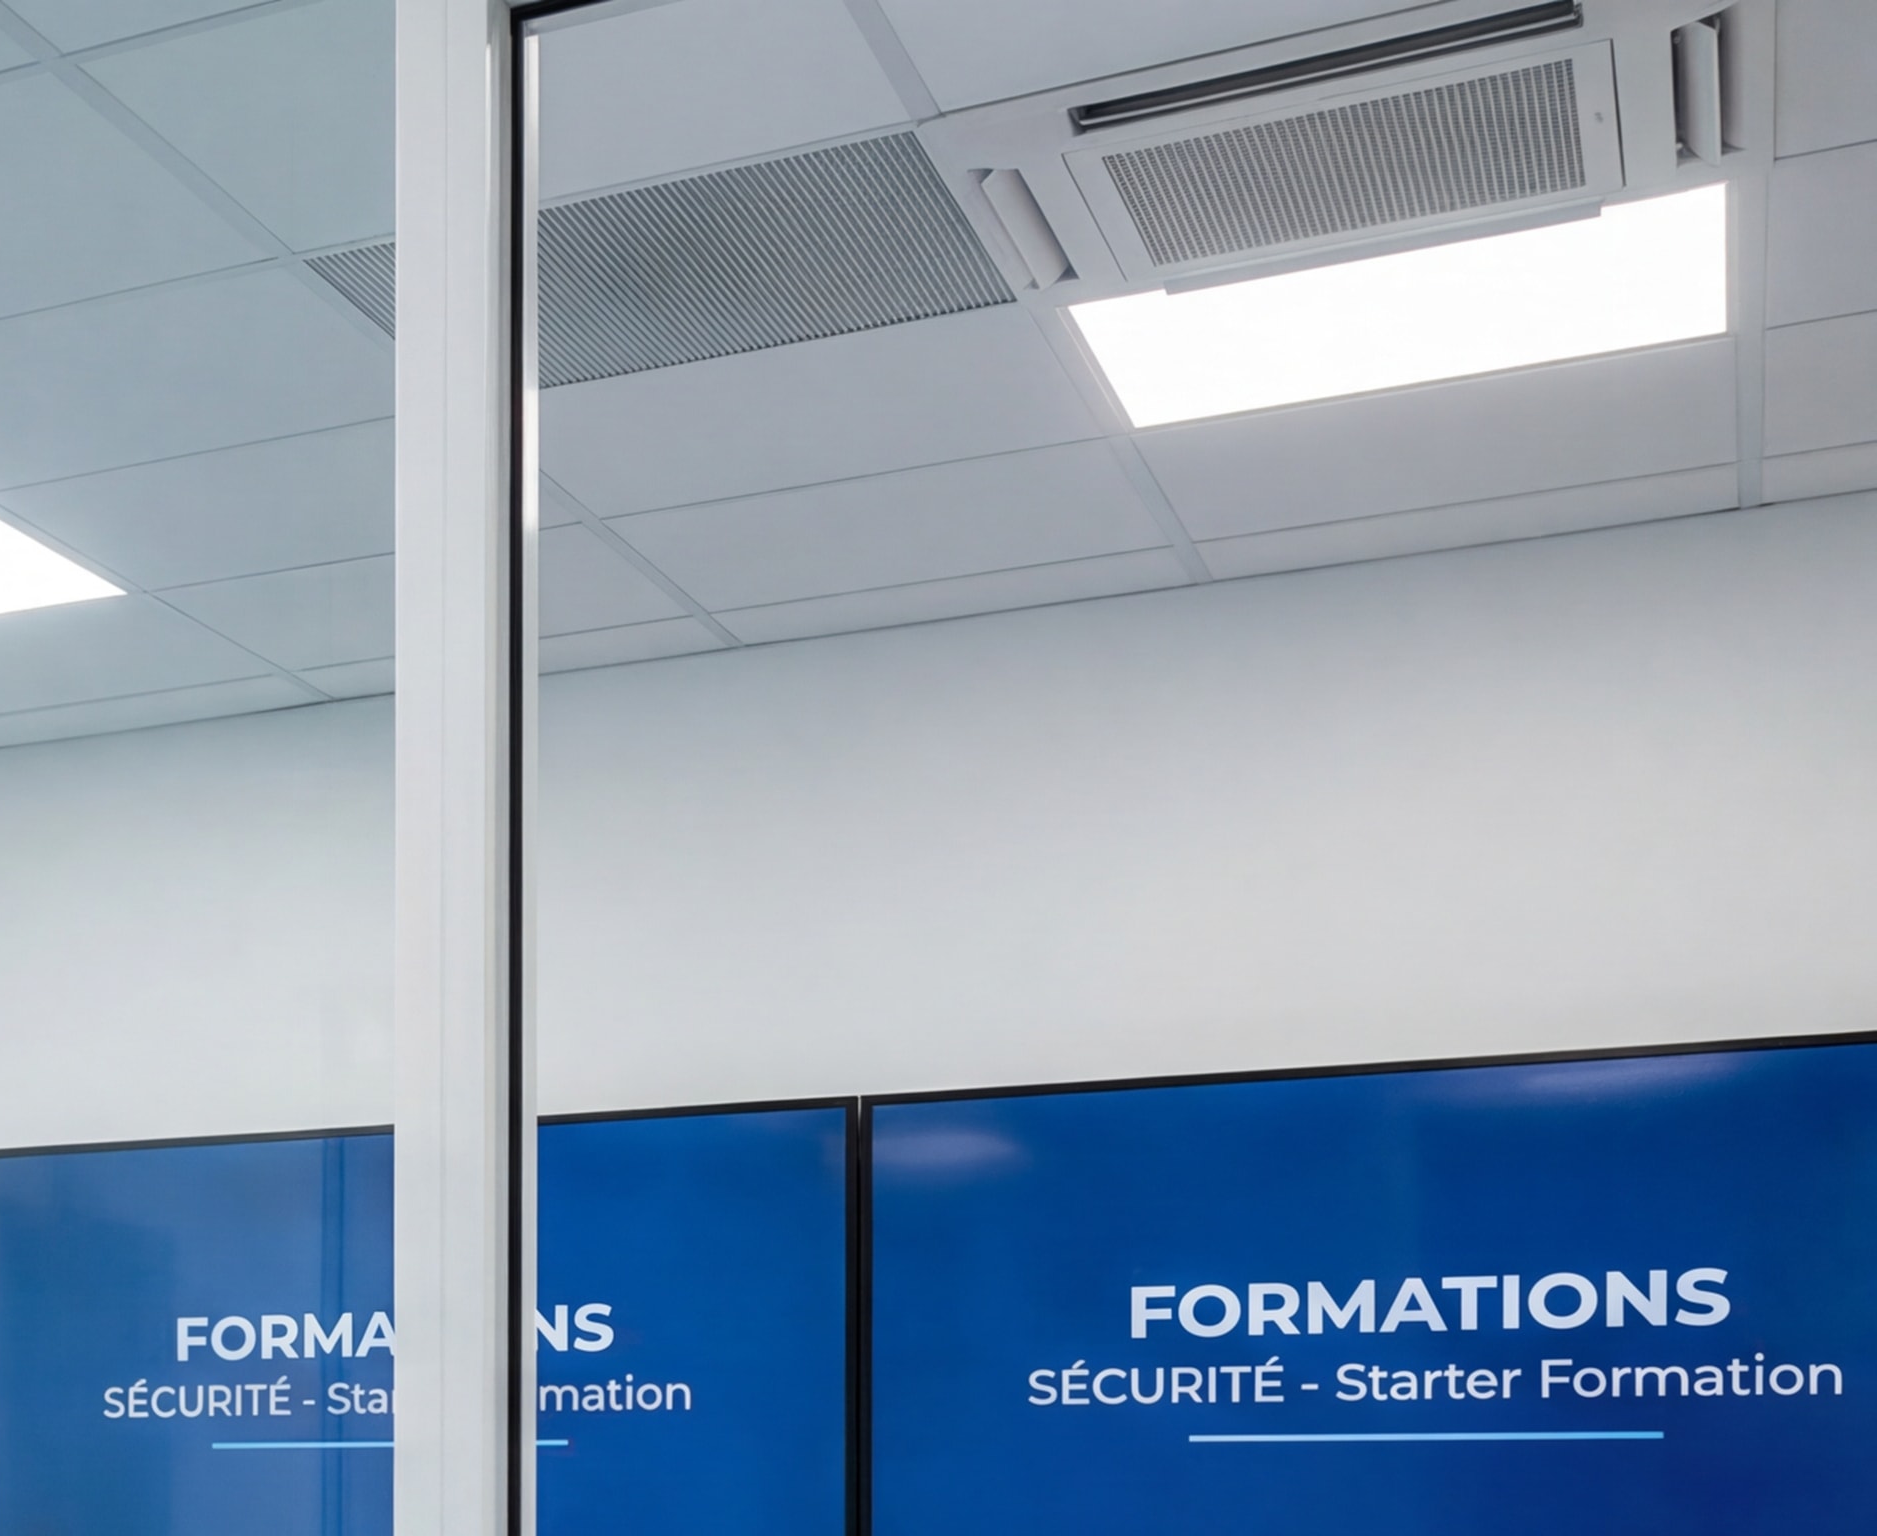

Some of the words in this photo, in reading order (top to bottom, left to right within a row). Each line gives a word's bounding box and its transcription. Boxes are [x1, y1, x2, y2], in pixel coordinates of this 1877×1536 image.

[1130, 1267, 1731, 1339] FORMATIONS
[176, 1302, 615, 1362] FORMANS
[103, 1375, 292, 1419] SÉCURITÉ
[539, 1373, 692, 1412] mation
[1028, 1355, 1285, 1406] SÉCURITÉ
[1335, 1363, 1522, 1402] Starter
[1541, 1352, 1843, 1399] Formation
